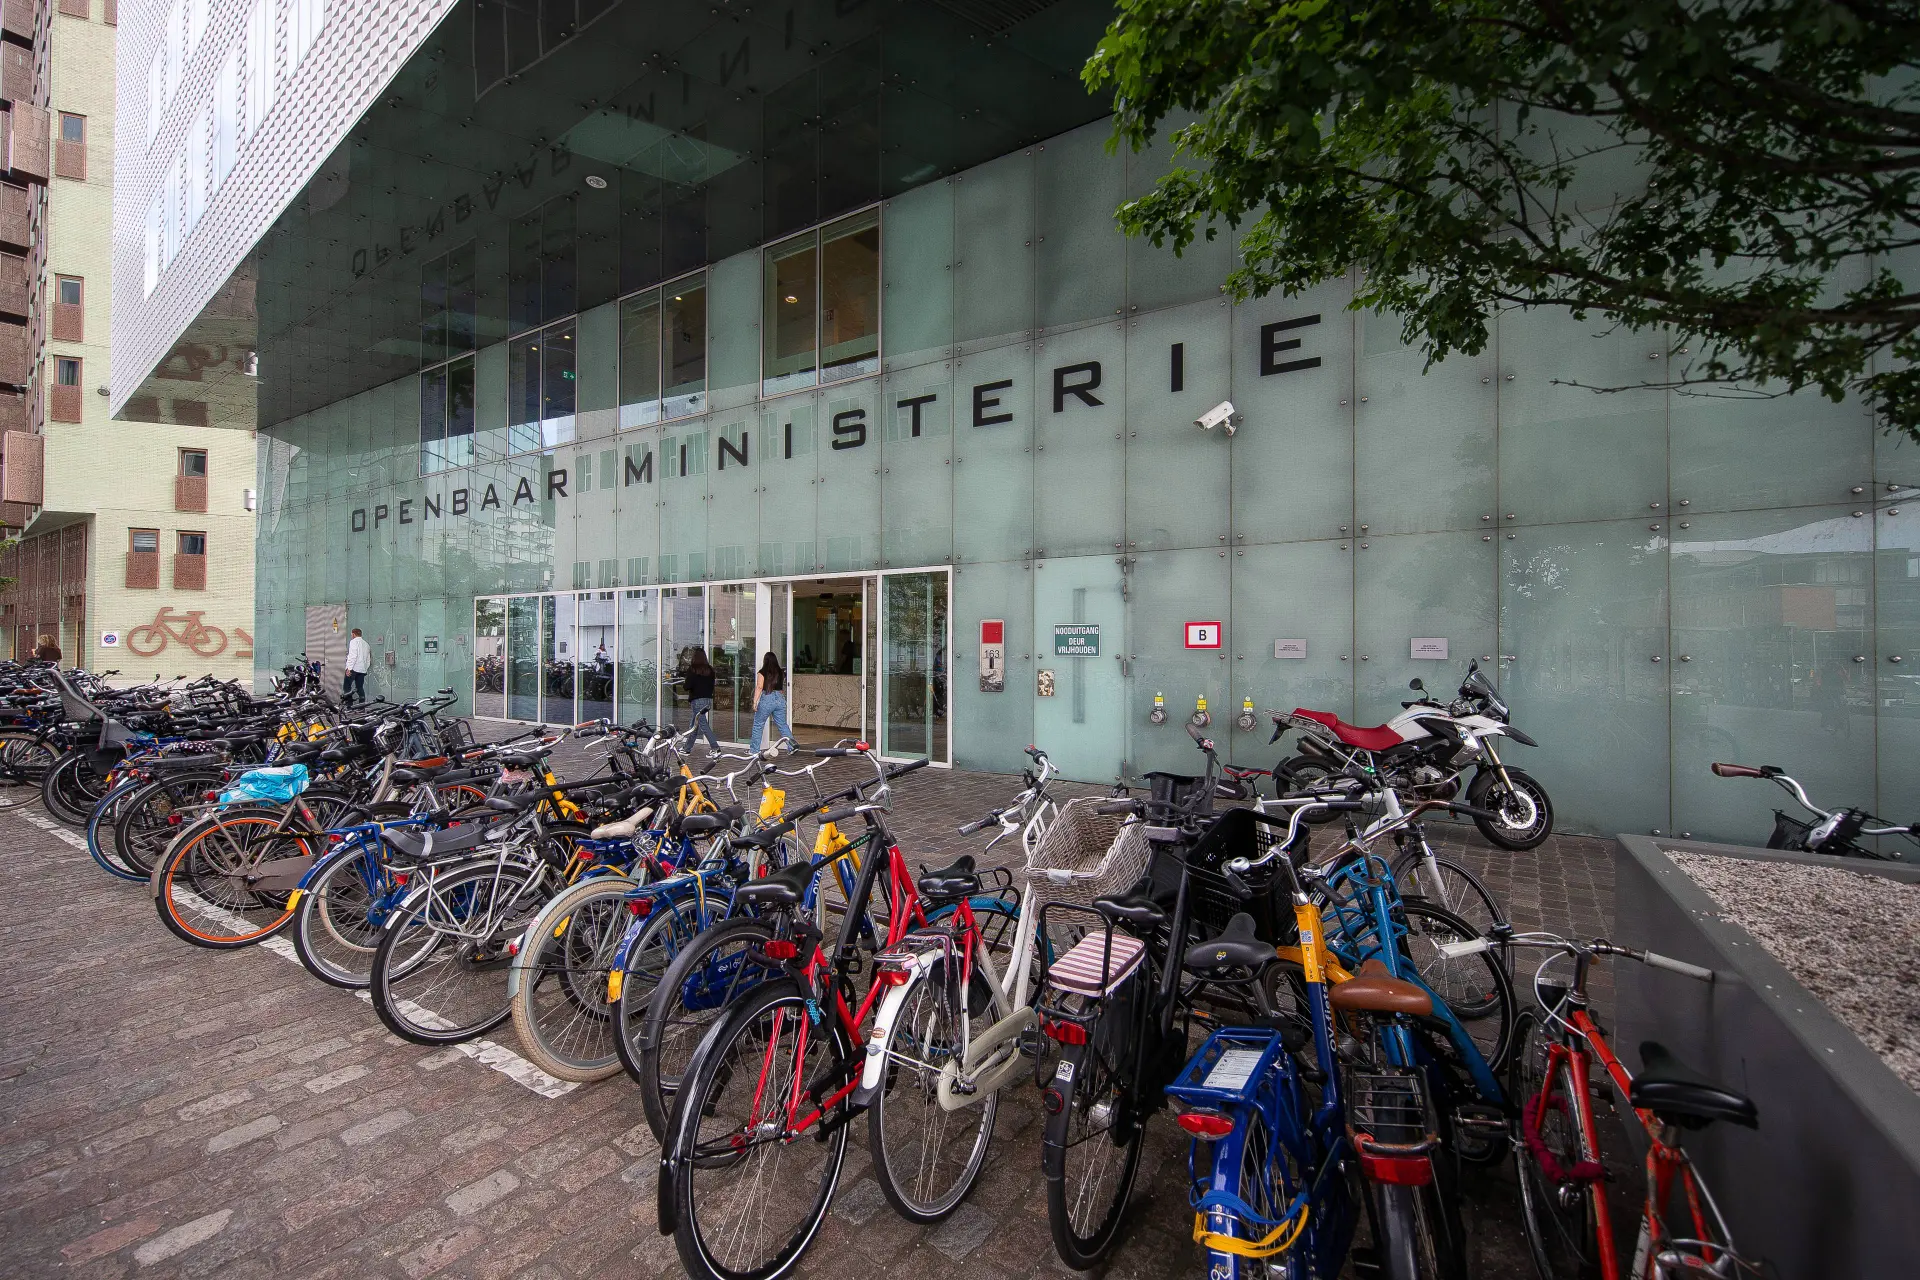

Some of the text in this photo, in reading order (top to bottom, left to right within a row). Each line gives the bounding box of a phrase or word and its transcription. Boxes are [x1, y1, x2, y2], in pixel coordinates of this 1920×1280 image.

[351, 313, 1322, 533] OPENBAAR MINISTERIE
[1055, 626, 1099, 635] NOODUITGANG
[1198, 629, 1207, 641] B
[1068, 637, 1085, 646] DEUR
[984, 649, 1000, 659] 163
[1057, 645, 1096, 654] VRIJHOUDEN
[474, 767, 495, 775] BIRD
